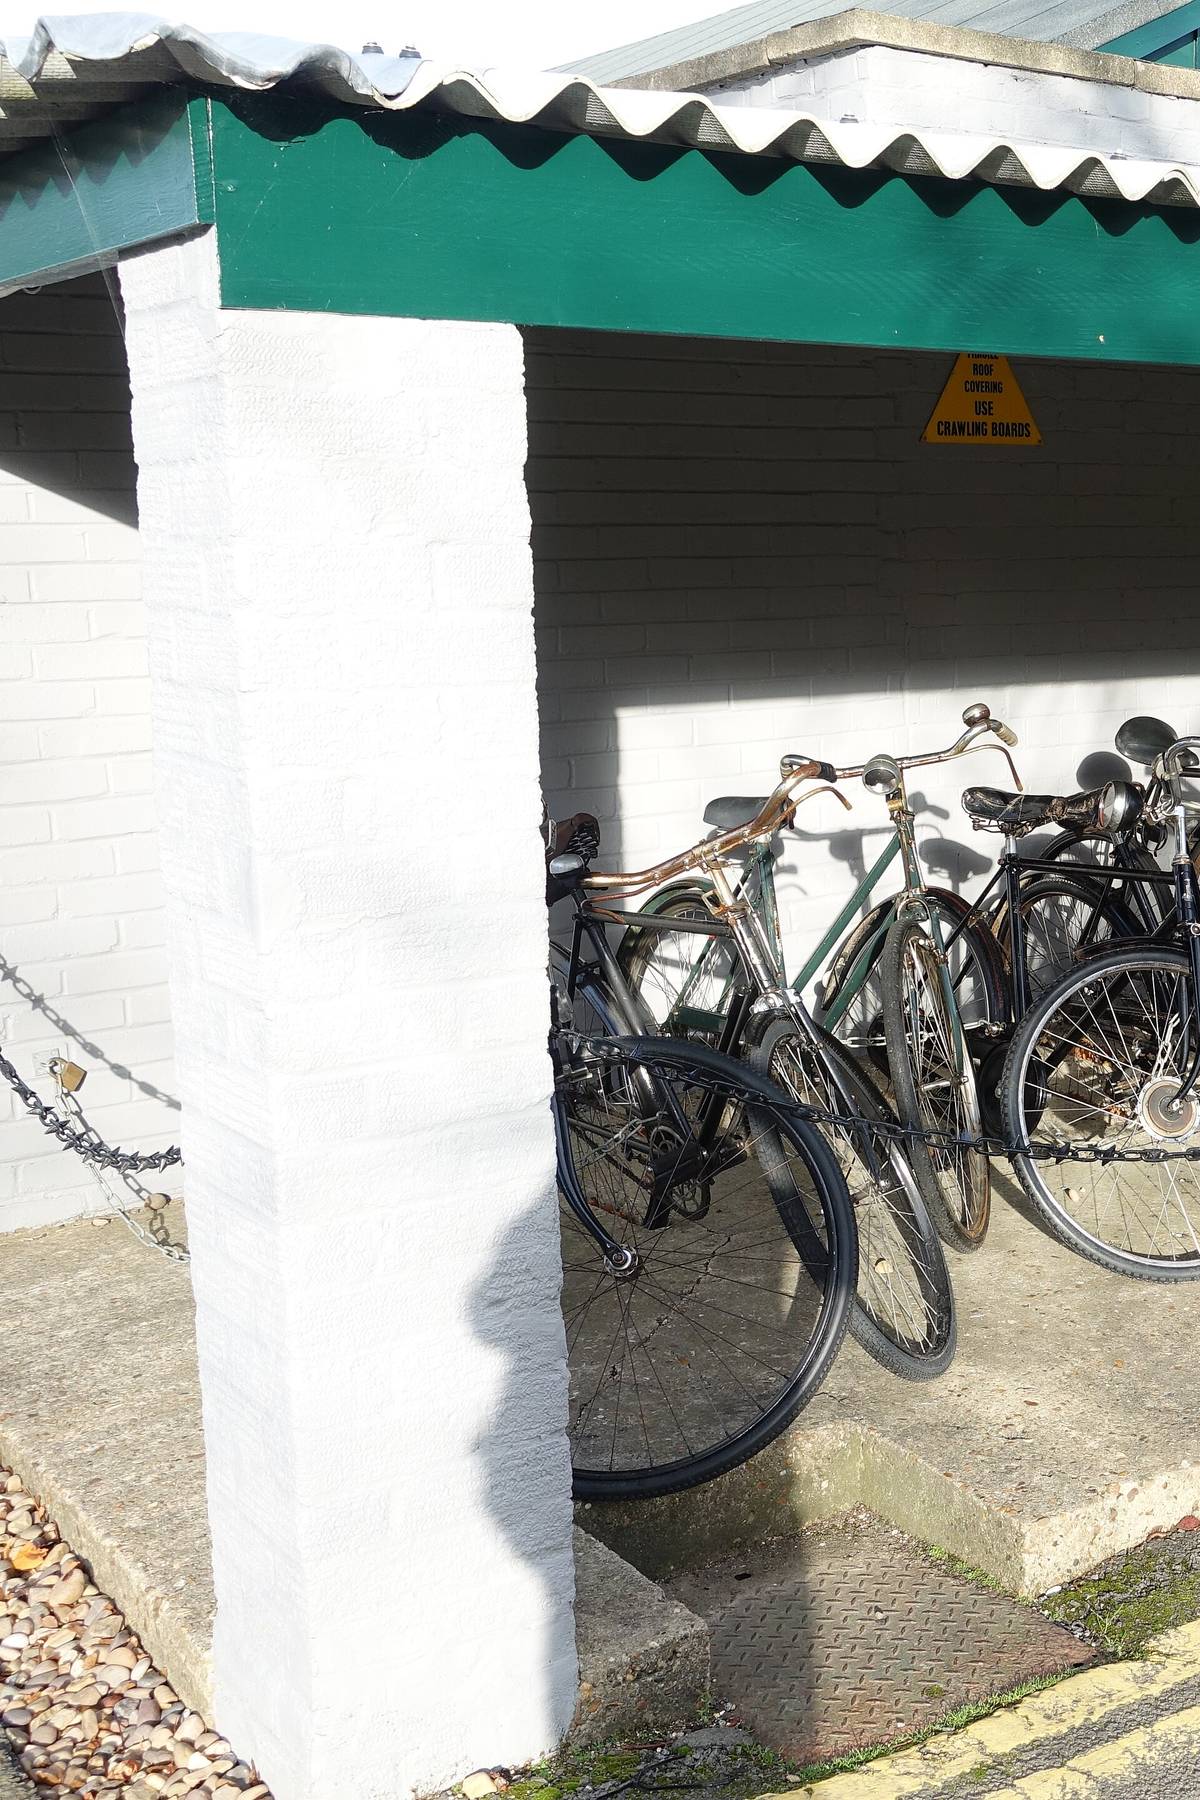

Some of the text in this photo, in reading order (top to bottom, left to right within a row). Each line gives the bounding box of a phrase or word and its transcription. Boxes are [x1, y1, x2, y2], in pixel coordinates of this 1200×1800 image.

[973, 364, 994, 376] ROOF
[964, 381, 1003, 393] COVERING
[975, 401, 994, 416] USE
[937, 421, 1031, 437] CRAWLING BOARDS
